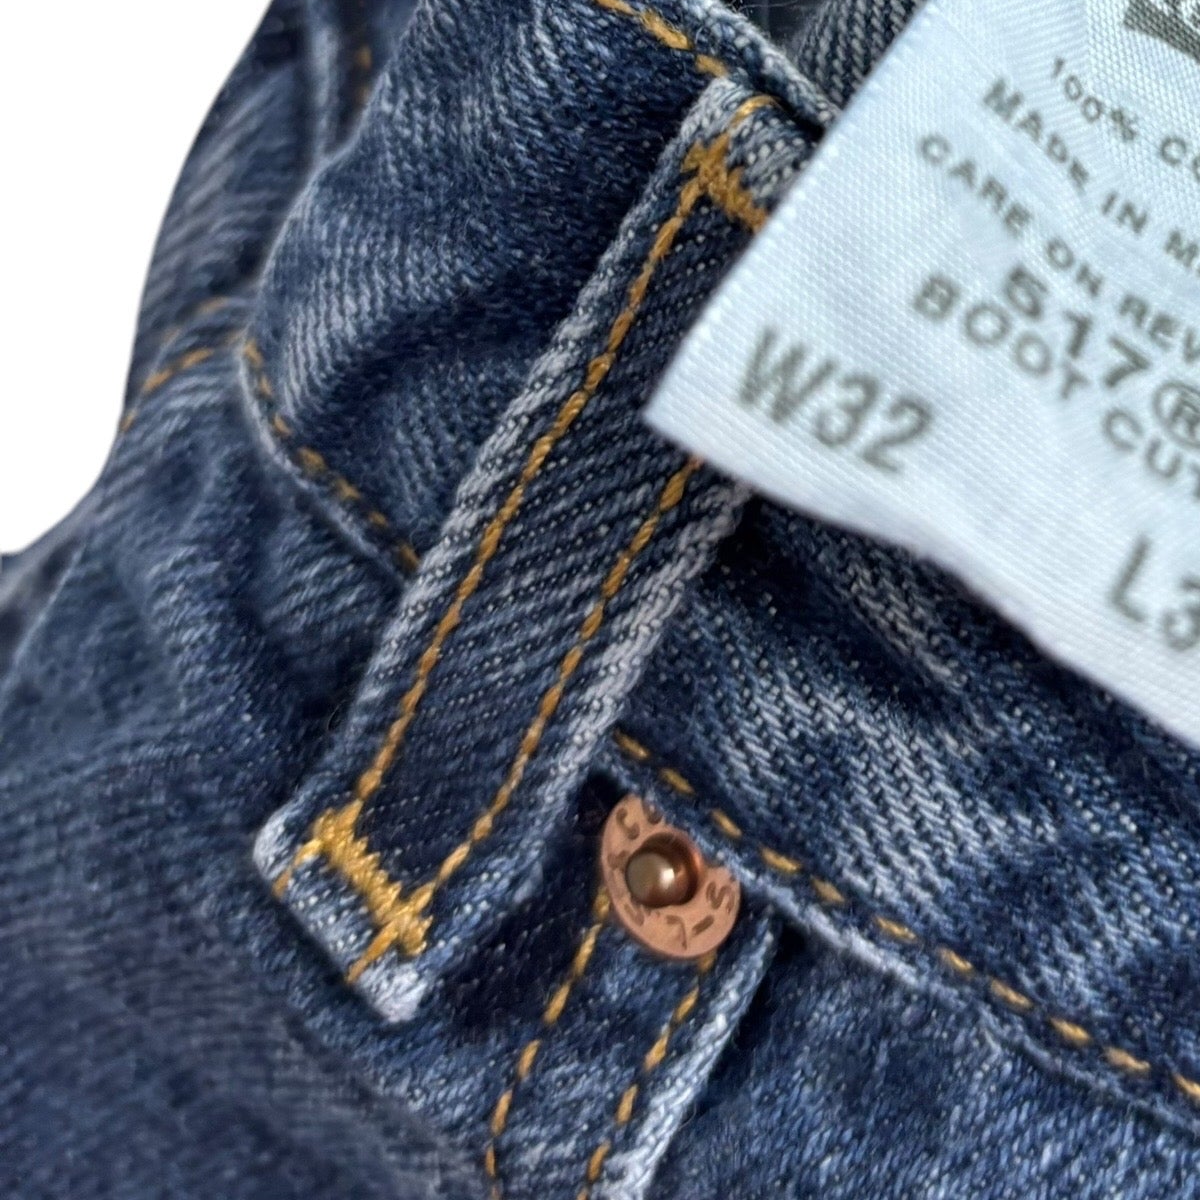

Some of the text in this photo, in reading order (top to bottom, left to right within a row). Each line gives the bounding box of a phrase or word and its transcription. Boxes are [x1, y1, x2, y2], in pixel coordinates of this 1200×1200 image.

[983, 78, 1090, 193] MADE
[1101, 191, 1148, 236] IN
[1053, 56, 1138, 142] 100%
[919, 133, 1032, 237] CARE
[1047, 237, 1103, 297] ON
[739, 322, 934, 474] W32
[911, 272, 1090, 400] BOOT
